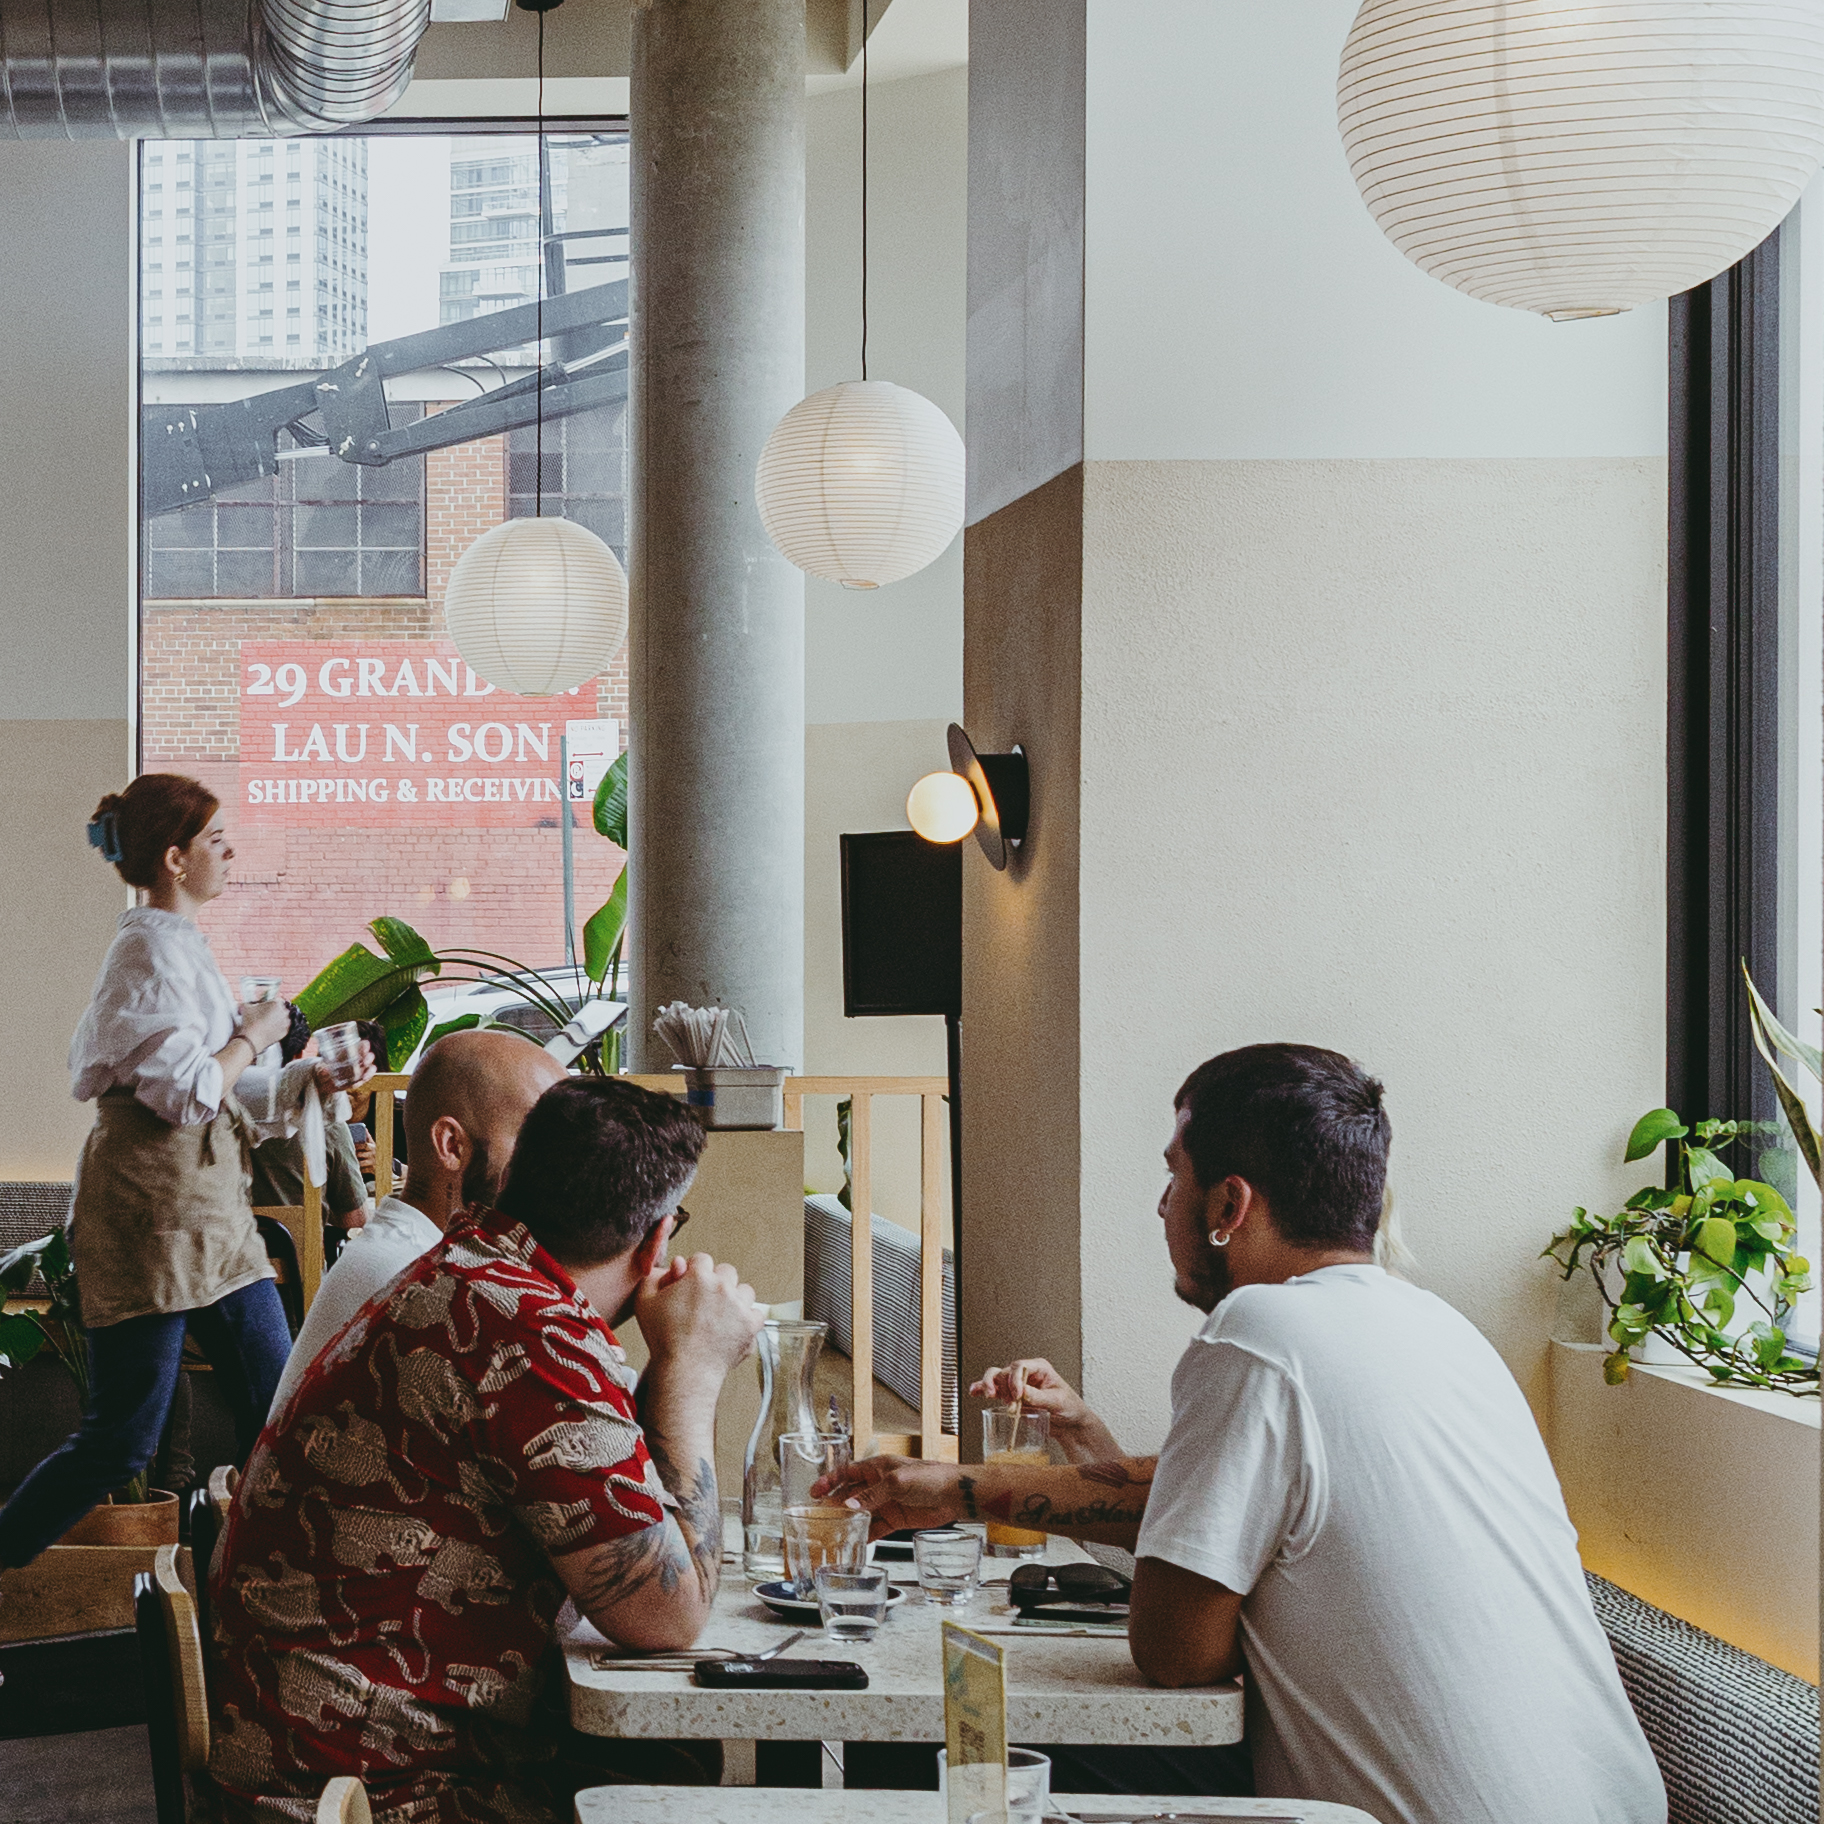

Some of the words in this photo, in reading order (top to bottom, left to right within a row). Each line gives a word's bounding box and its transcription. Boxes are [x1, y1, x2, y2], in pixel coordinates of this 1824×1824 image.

[247, 663, 307, 708] 29
[271, 723, 370, 762] LAU
[382, 723, 433, 762] N.
[447, 722, 552, 762] SON
[247, 778, 390, 803] SHIPPING
[396, 778, 419, 803] &
[426, 777, 562, 802] RECEIVIN
